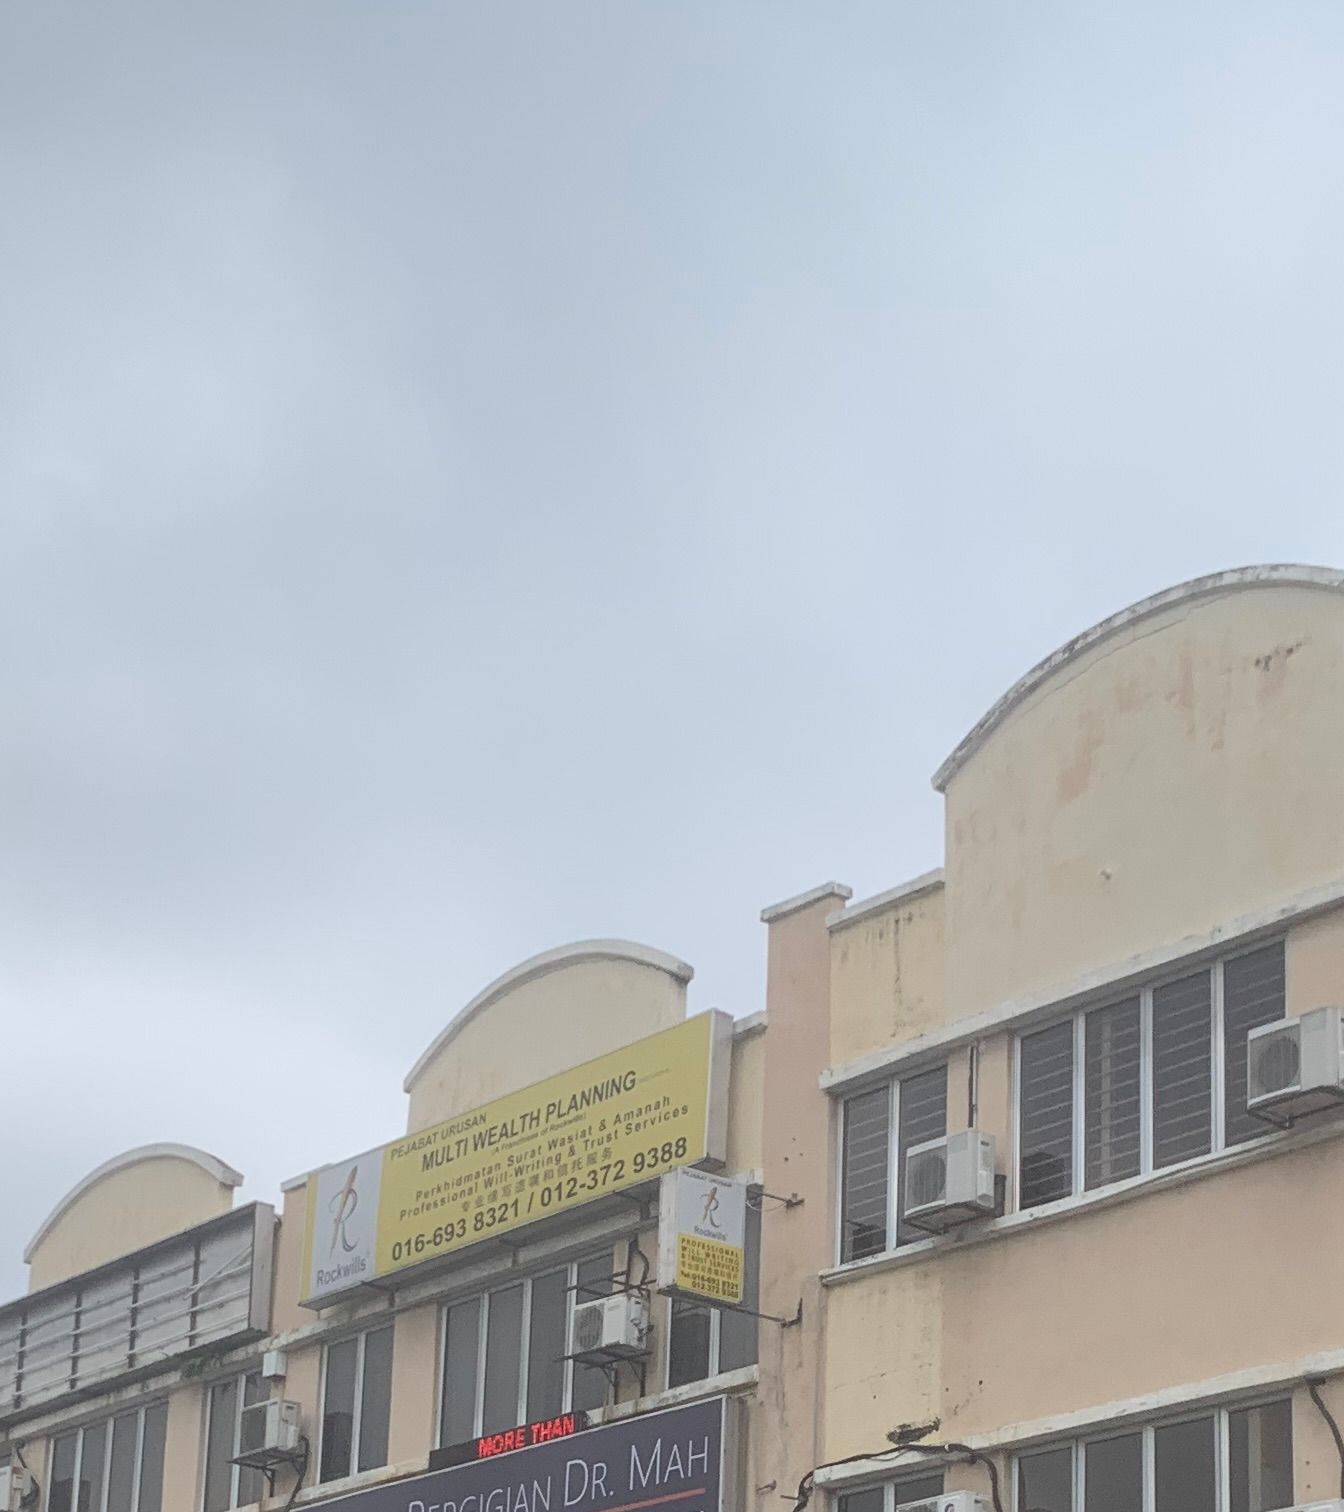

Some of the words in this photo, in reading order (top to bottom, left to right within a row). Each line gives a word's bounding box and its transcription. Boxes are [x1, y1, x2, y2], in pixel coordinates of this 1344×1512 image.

[390, 1131, 439, 1161] PEJABAT
[441, 1112, 487, 1141] URUSAN
[415, 1162, 502, 1203] Perkhidmatan
[507, 1144, 543, 1168] Surat
[547, 1125, 593, 1152] Wasiat
[598, 1118, 607, 1132] &
[613, 1095, 671, 1126] Amanah
[422, 1136, 470, 1173] MULTI
[472, 1107, 542, 1152] WEALTH
[545, 1069, 637, 1124] PLANNING
[391, 1217, 467, 1262] 016-693
[473, 1198, 520, 1233] 8321
[526, 1191, 535, 1213] /
[540, 1159, 625, 1208] 012-372
[632, 1137, 688, 1175] 9388
[399, 1182, 479, 1222] Professional
[483, 1150, 562, 1191] Will-Writing
[567, 1145, 576, 1158] &
[583, 1128, 619, 1152] Trust
[624, 1104, 689, 1136] Services
[316, 1255, 368, 1288] Rockwills
[478, 1426, 526, 1458] MORE
[530, 1415, 575, 1445] THAN
[629, 1435, 709, 1491] MAH
